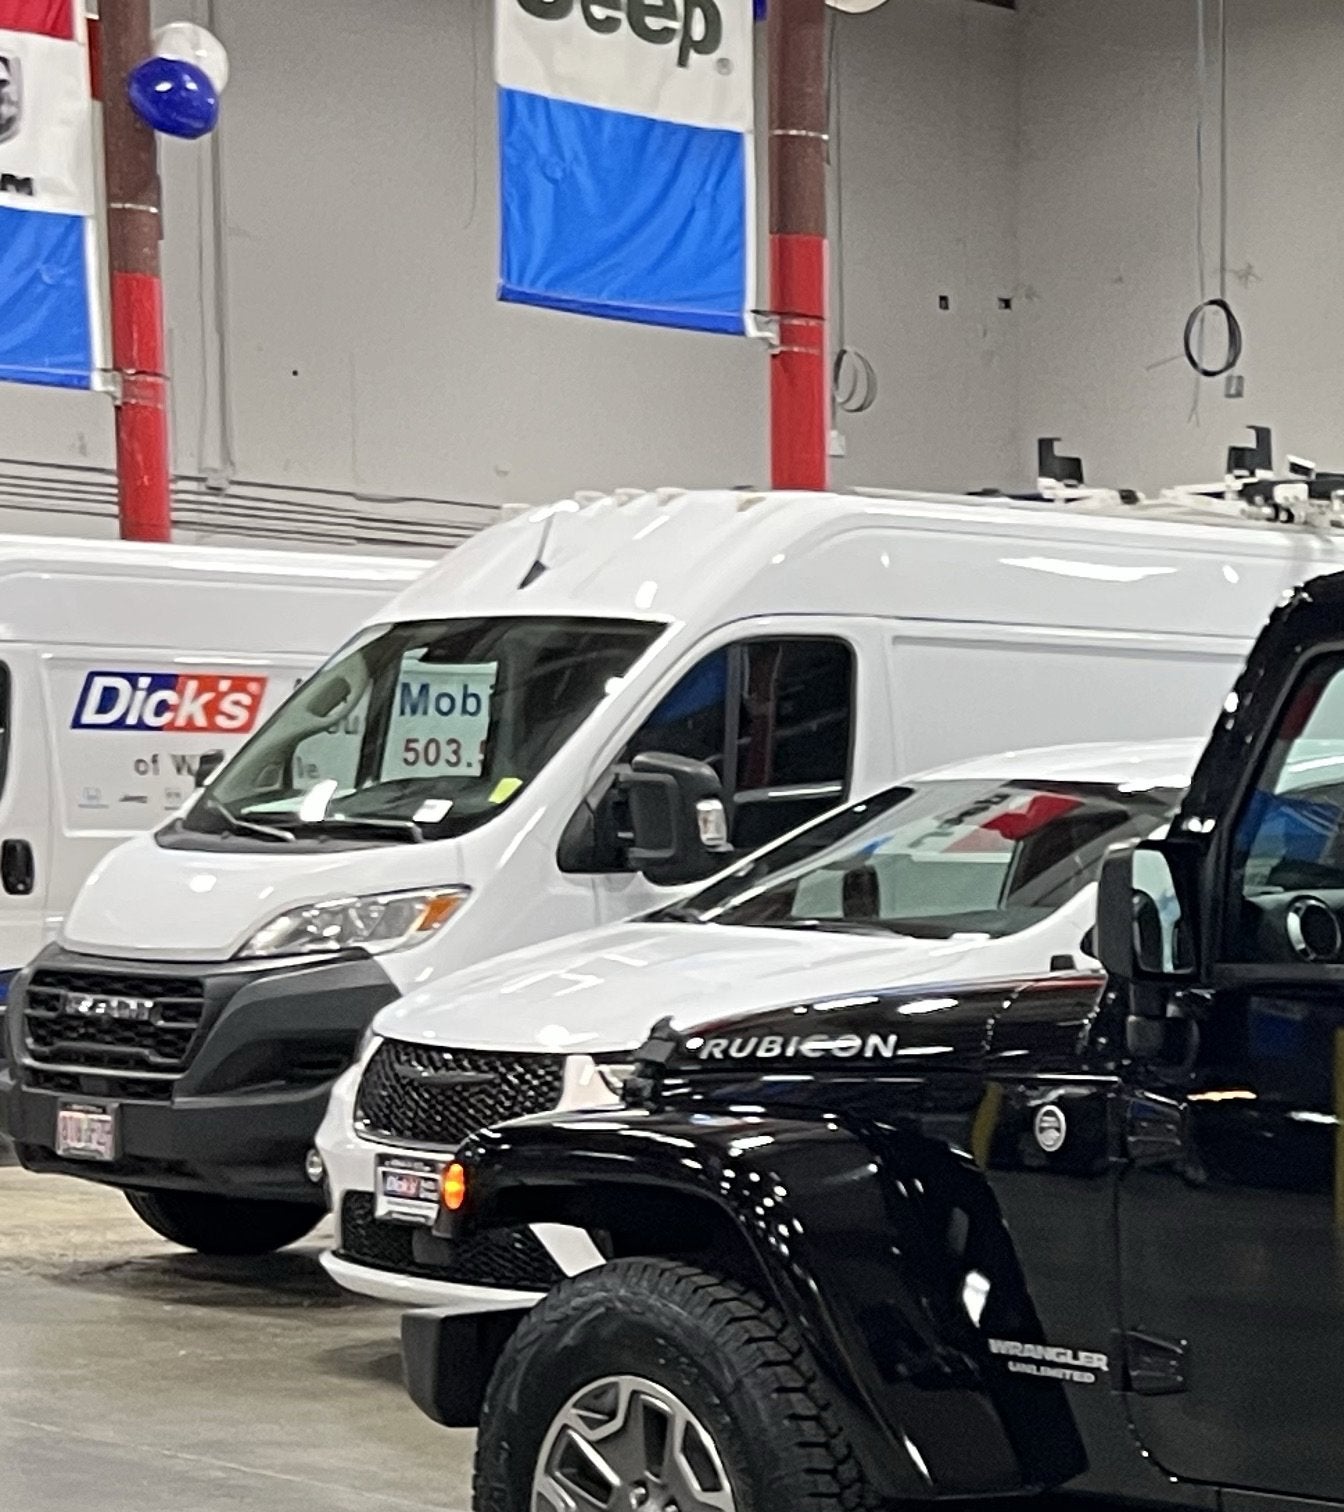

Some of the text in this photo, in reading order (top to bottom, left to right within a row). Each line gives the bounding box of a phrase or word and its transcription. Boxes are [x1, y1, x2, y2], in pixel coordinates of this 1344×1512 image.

[516, 0, 713, 68] eep
[80, 676, 252, 729] Dick's
[399, 682, 495, 717] Mob
[134, 753, 160, 776] of
[699, 1033, 898, 1060] RUBICON
[988, 1338, 1109, 1371] WRANGLER
